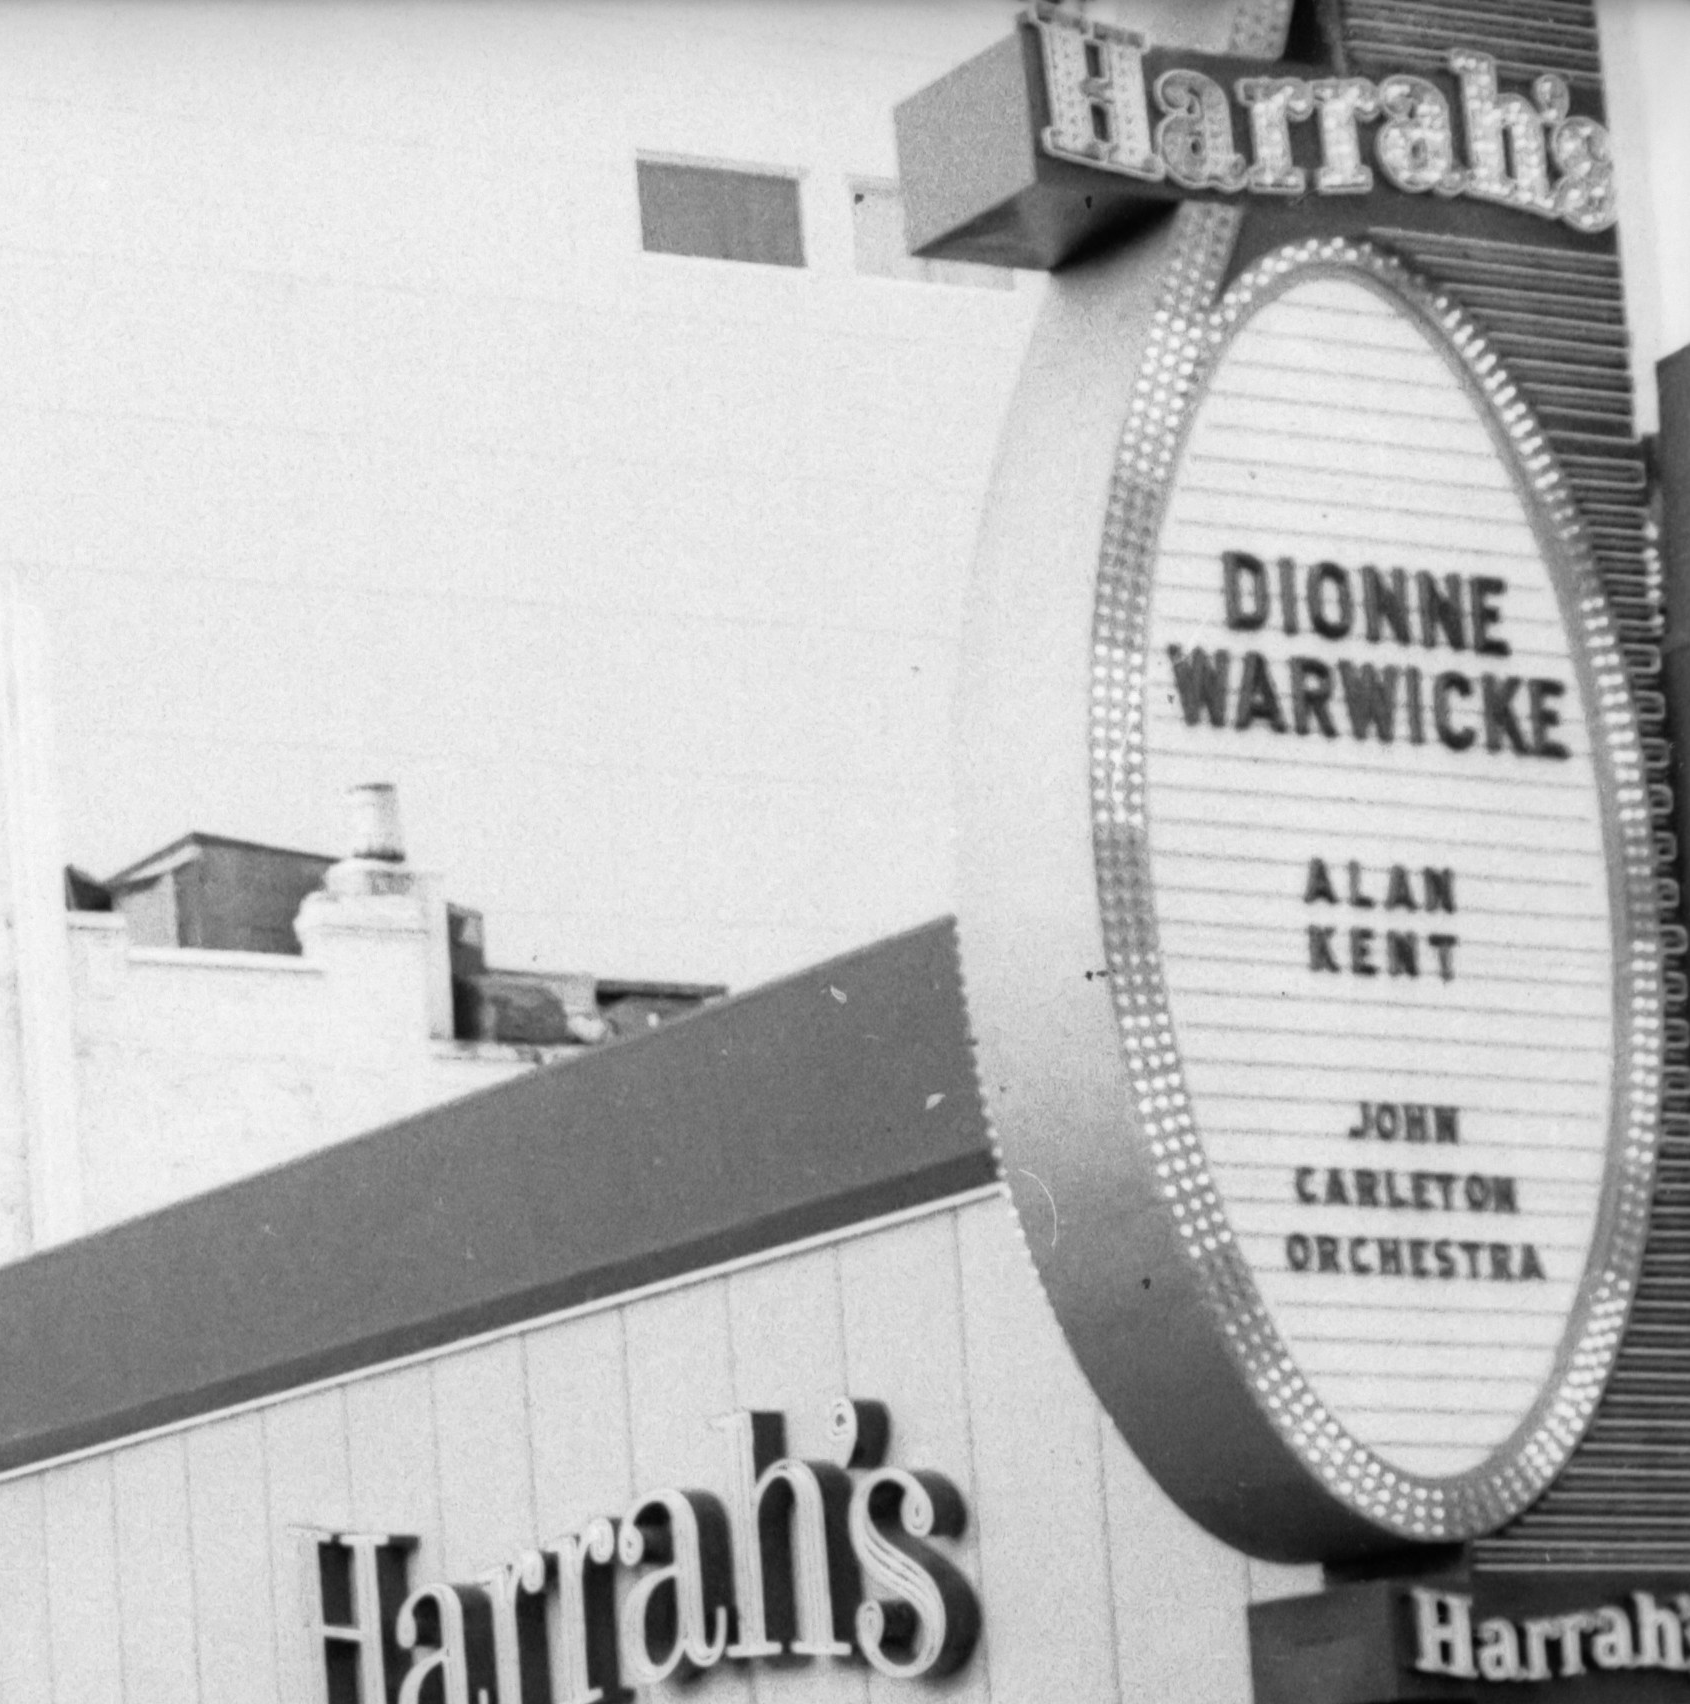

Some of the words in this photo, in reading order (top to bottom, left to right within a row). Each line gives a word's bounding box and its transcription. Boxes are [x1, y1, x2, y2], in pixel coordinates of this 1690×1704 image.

[1024, 7, 1618, 232] Harrah's
[1221, 550, 1511, 658] DIONNE
[1169, 643, 1570, 761] WARWICKE
[1303, 857, 1457, 914] ALAN
[1305, 924, 1459, 981] KENT
[1348, 1100, 1460, 1145] JOHN
[1294, 1166, 1519, 1213] CARLETON
[1285, 1233, 1546, 1281] ORCHESTRA
[1411, 1586, 1690, 1681] Harrah'
